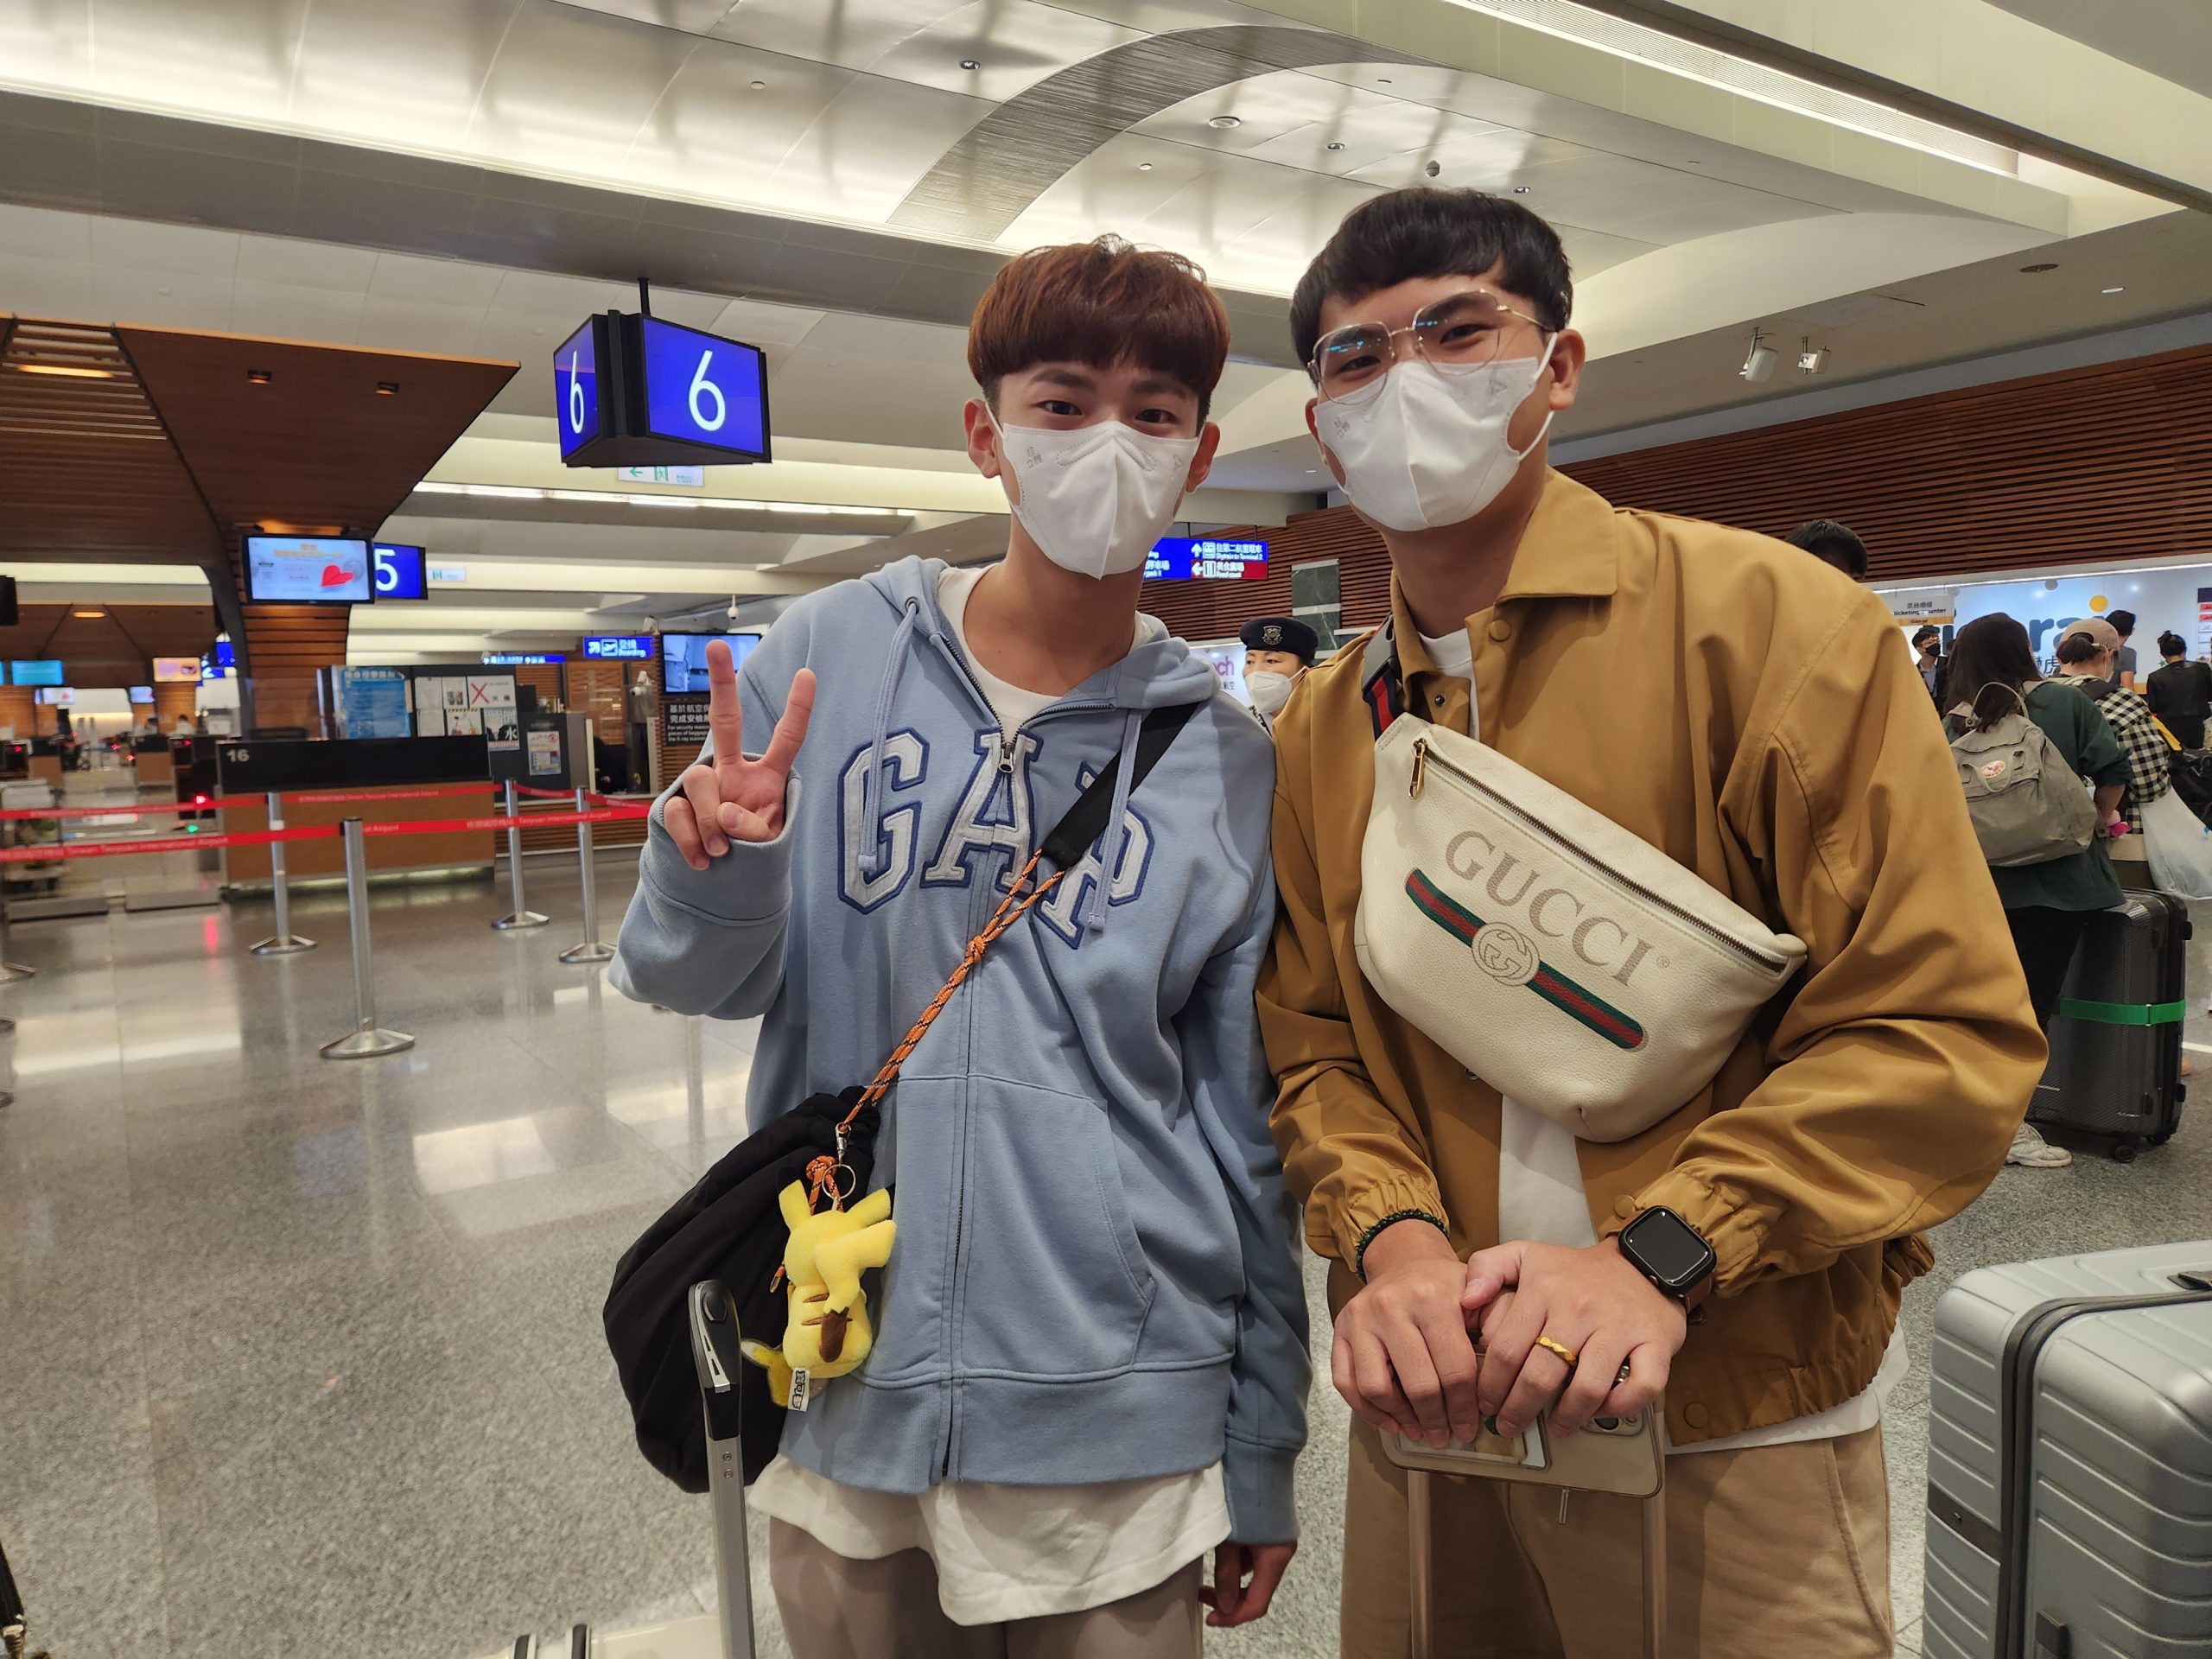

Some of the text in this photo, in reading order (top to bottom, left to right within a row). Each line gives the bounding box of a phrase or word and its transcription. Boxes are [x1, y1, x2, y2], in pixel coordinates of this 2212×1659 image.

[570, 350, 585, 435] 6
[689, 349, 726, 432] 6
[374, 549, 398, 592] 5
[618, 648, 647, 658] Boarding
[226, 748, 250, 763] 16
[372, 824, 399, 834] Airport
[1445, 829, 1654, 988] GUCCI
